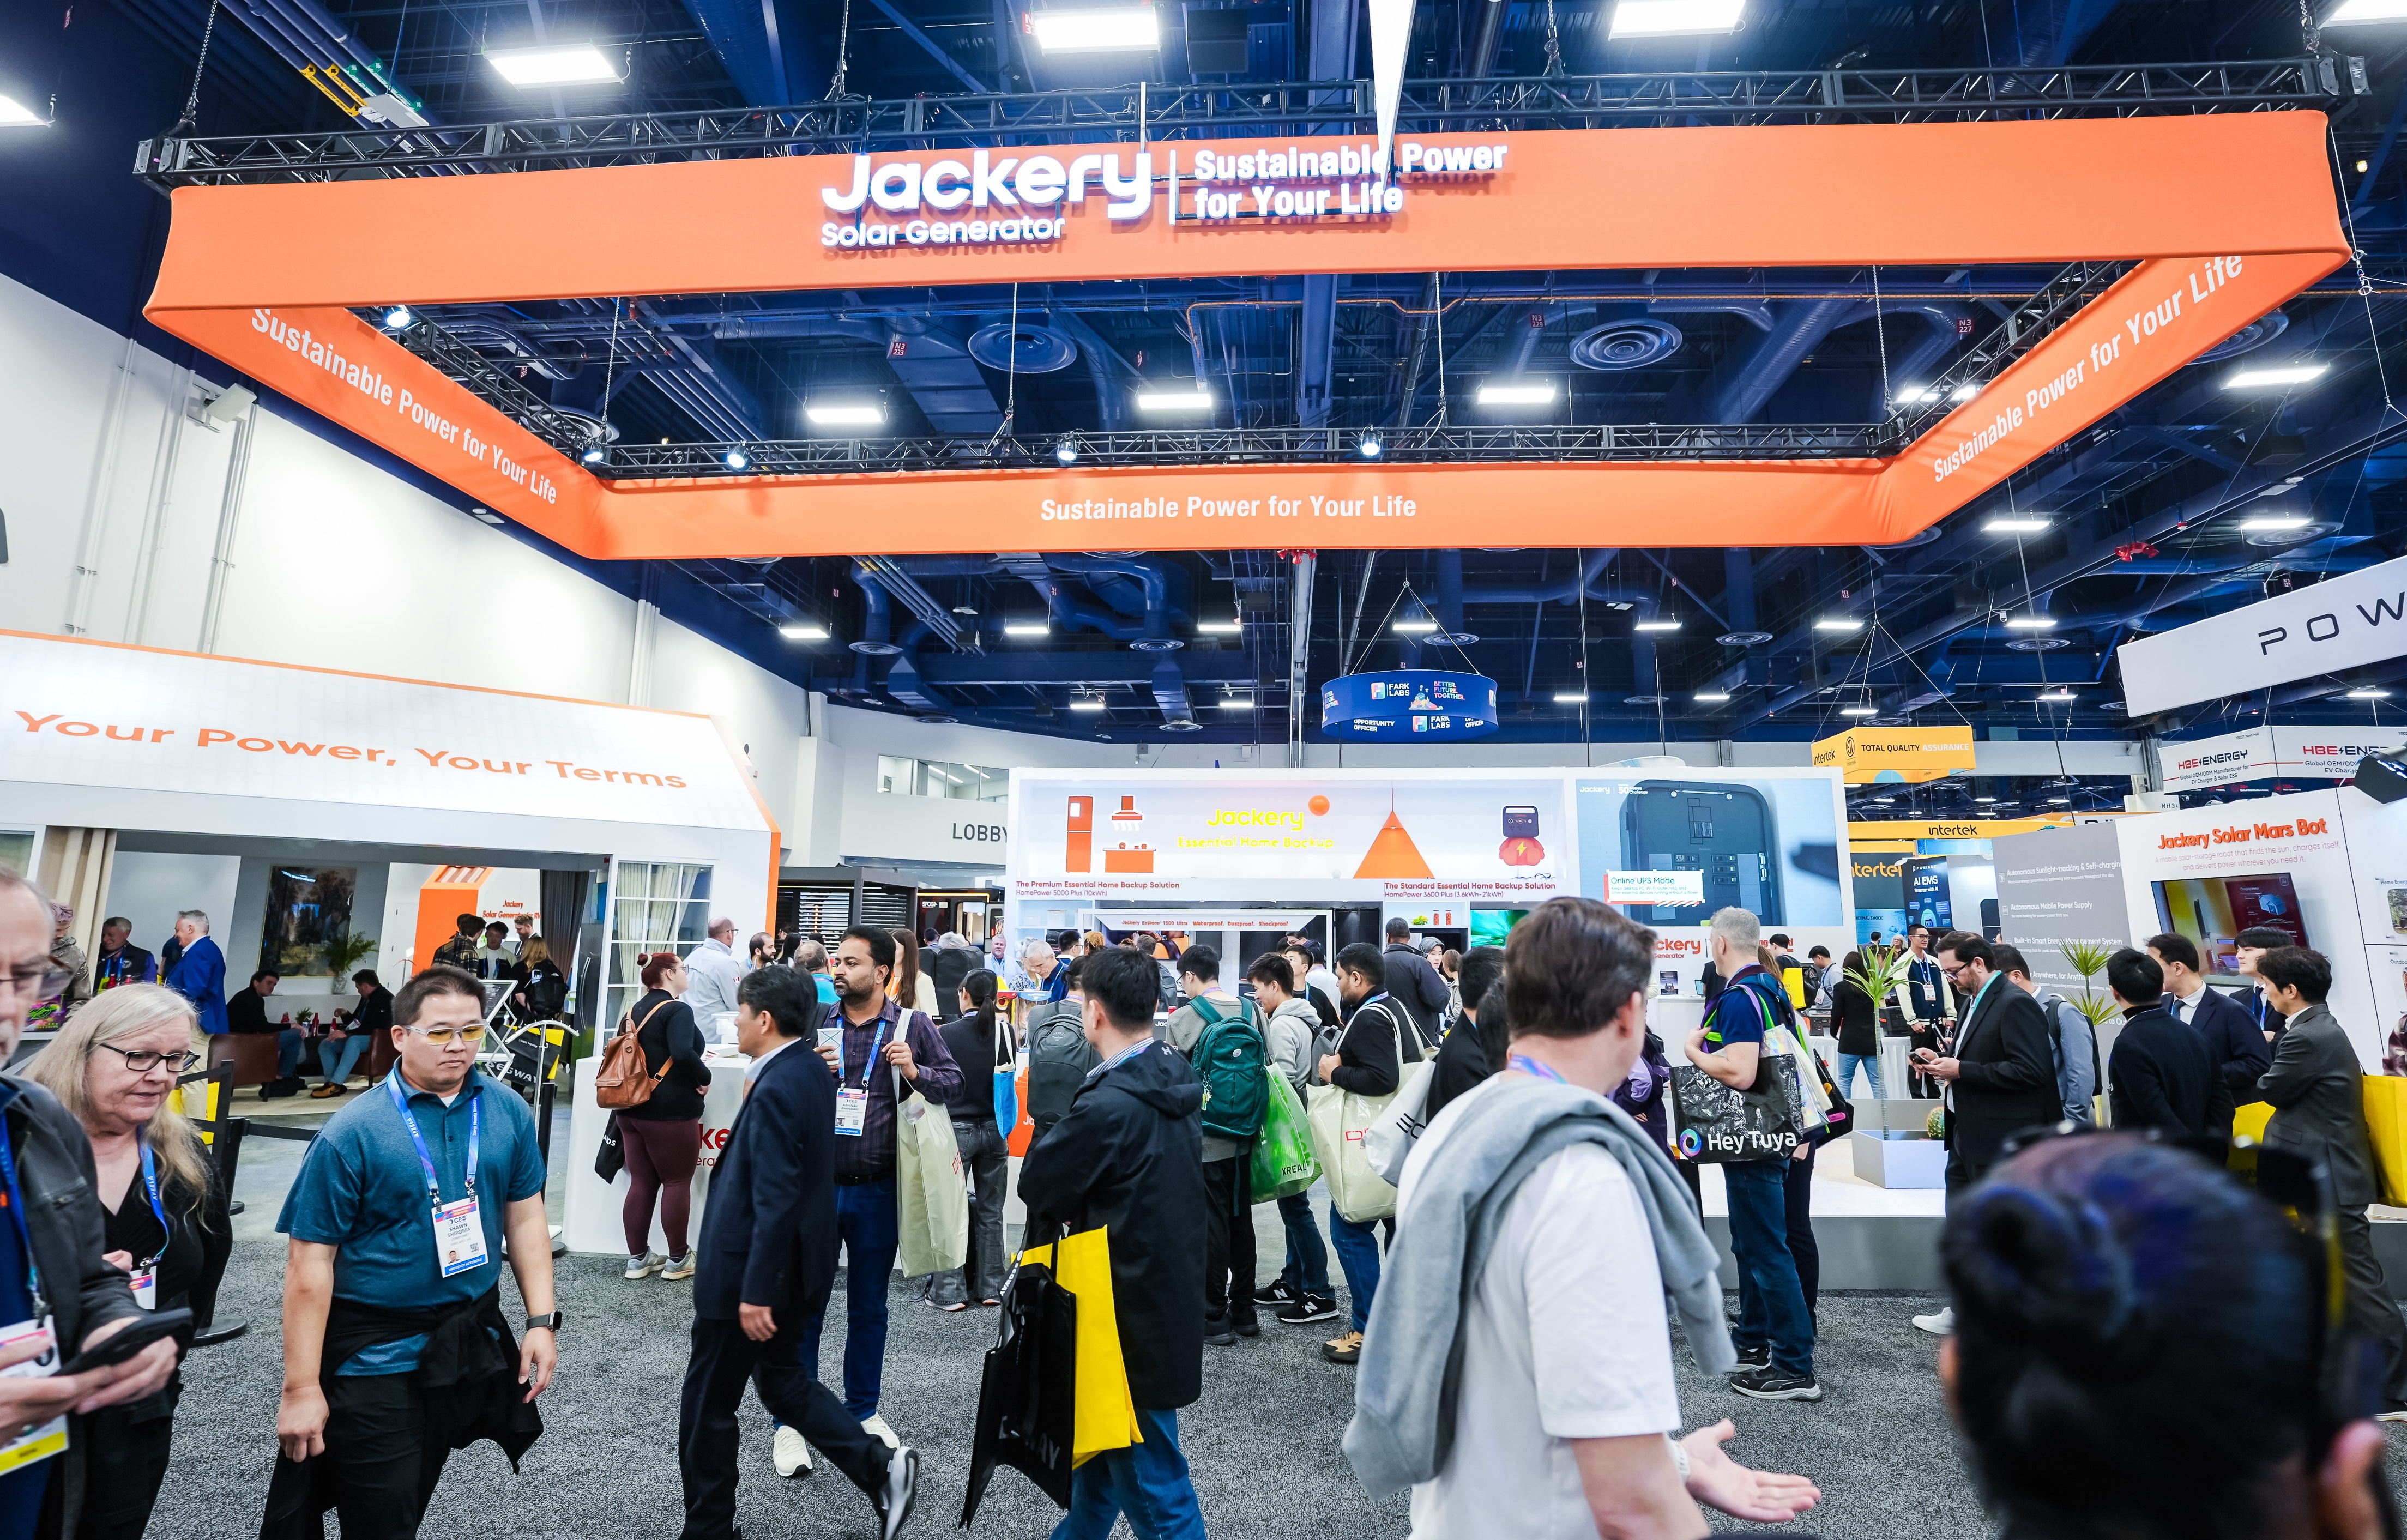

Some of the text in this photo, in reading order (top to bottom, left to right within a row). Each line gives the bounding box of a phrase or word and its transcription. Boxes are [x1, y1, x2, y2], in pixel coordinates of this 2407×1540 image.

[1402, 142, 1508, 173] Power
[822, 150, 1153, 220] Jackery
[1193, 182, 1403, 218] for Your Life
[822, 215, 1065, 247] Solar Generator
[1934, 255, 2243, 483] Sustainable Power for Your Life
[251, 309, 558, 504] Sustainable Power for Your Life
[1041, 495, 1417, 520] Sustainable Power for Your Life
[2258, 591, 2405, 655] POW
[15, 710, 688, 789] Your Power, Your Terms
[1813, 748, 1836, 765] intertek
[2303, 746, 2338, 755] HBE
[2178, 750, 2248, 770] HBE ENERGY
[2213, 765, 2241, 775] Manufacturer
[1206, 808, 1304, 831] Jackery
[1929, 825, 1978, 835] intertek
[2158, 818, 2327, 849] Jackery Solar Mars Bot
[1178, 836, 1334, 849] Essential Home Backup
[2179, 852, 2216, 861] solar-storage
[2293, 843, 2320, 851] charges
[2322, 841, 2340, 849] itself,
[2036, 863, 2080, 874] Sunlight-tracking
[2218, 861, 2236, 869] power
[2238, 858, 2265, 867] wherever
[2267, 858, 2279, 866] you
[1914, 875, 1938, 886] AI EMS
[503, 900, 523, 909] Jackery
[2074, 901, 2092, 910] Supply
[1656, 939, 1701, 954] ckery
[2048, 937, 2064, 946] Energy
[2102, 937, 2123, 946] System
[2034, 971, 2058, 980] Anywhere,
[1708, 1131, 1797, 1154] Hey Tuya
[1282, 1163, 1307, 1176] XREAL
[454, 1215, 467, 1223] CES
[448, 1227, 470, 1237] SHIROMA
[449, 1223, 468, 1232] SHAWN
